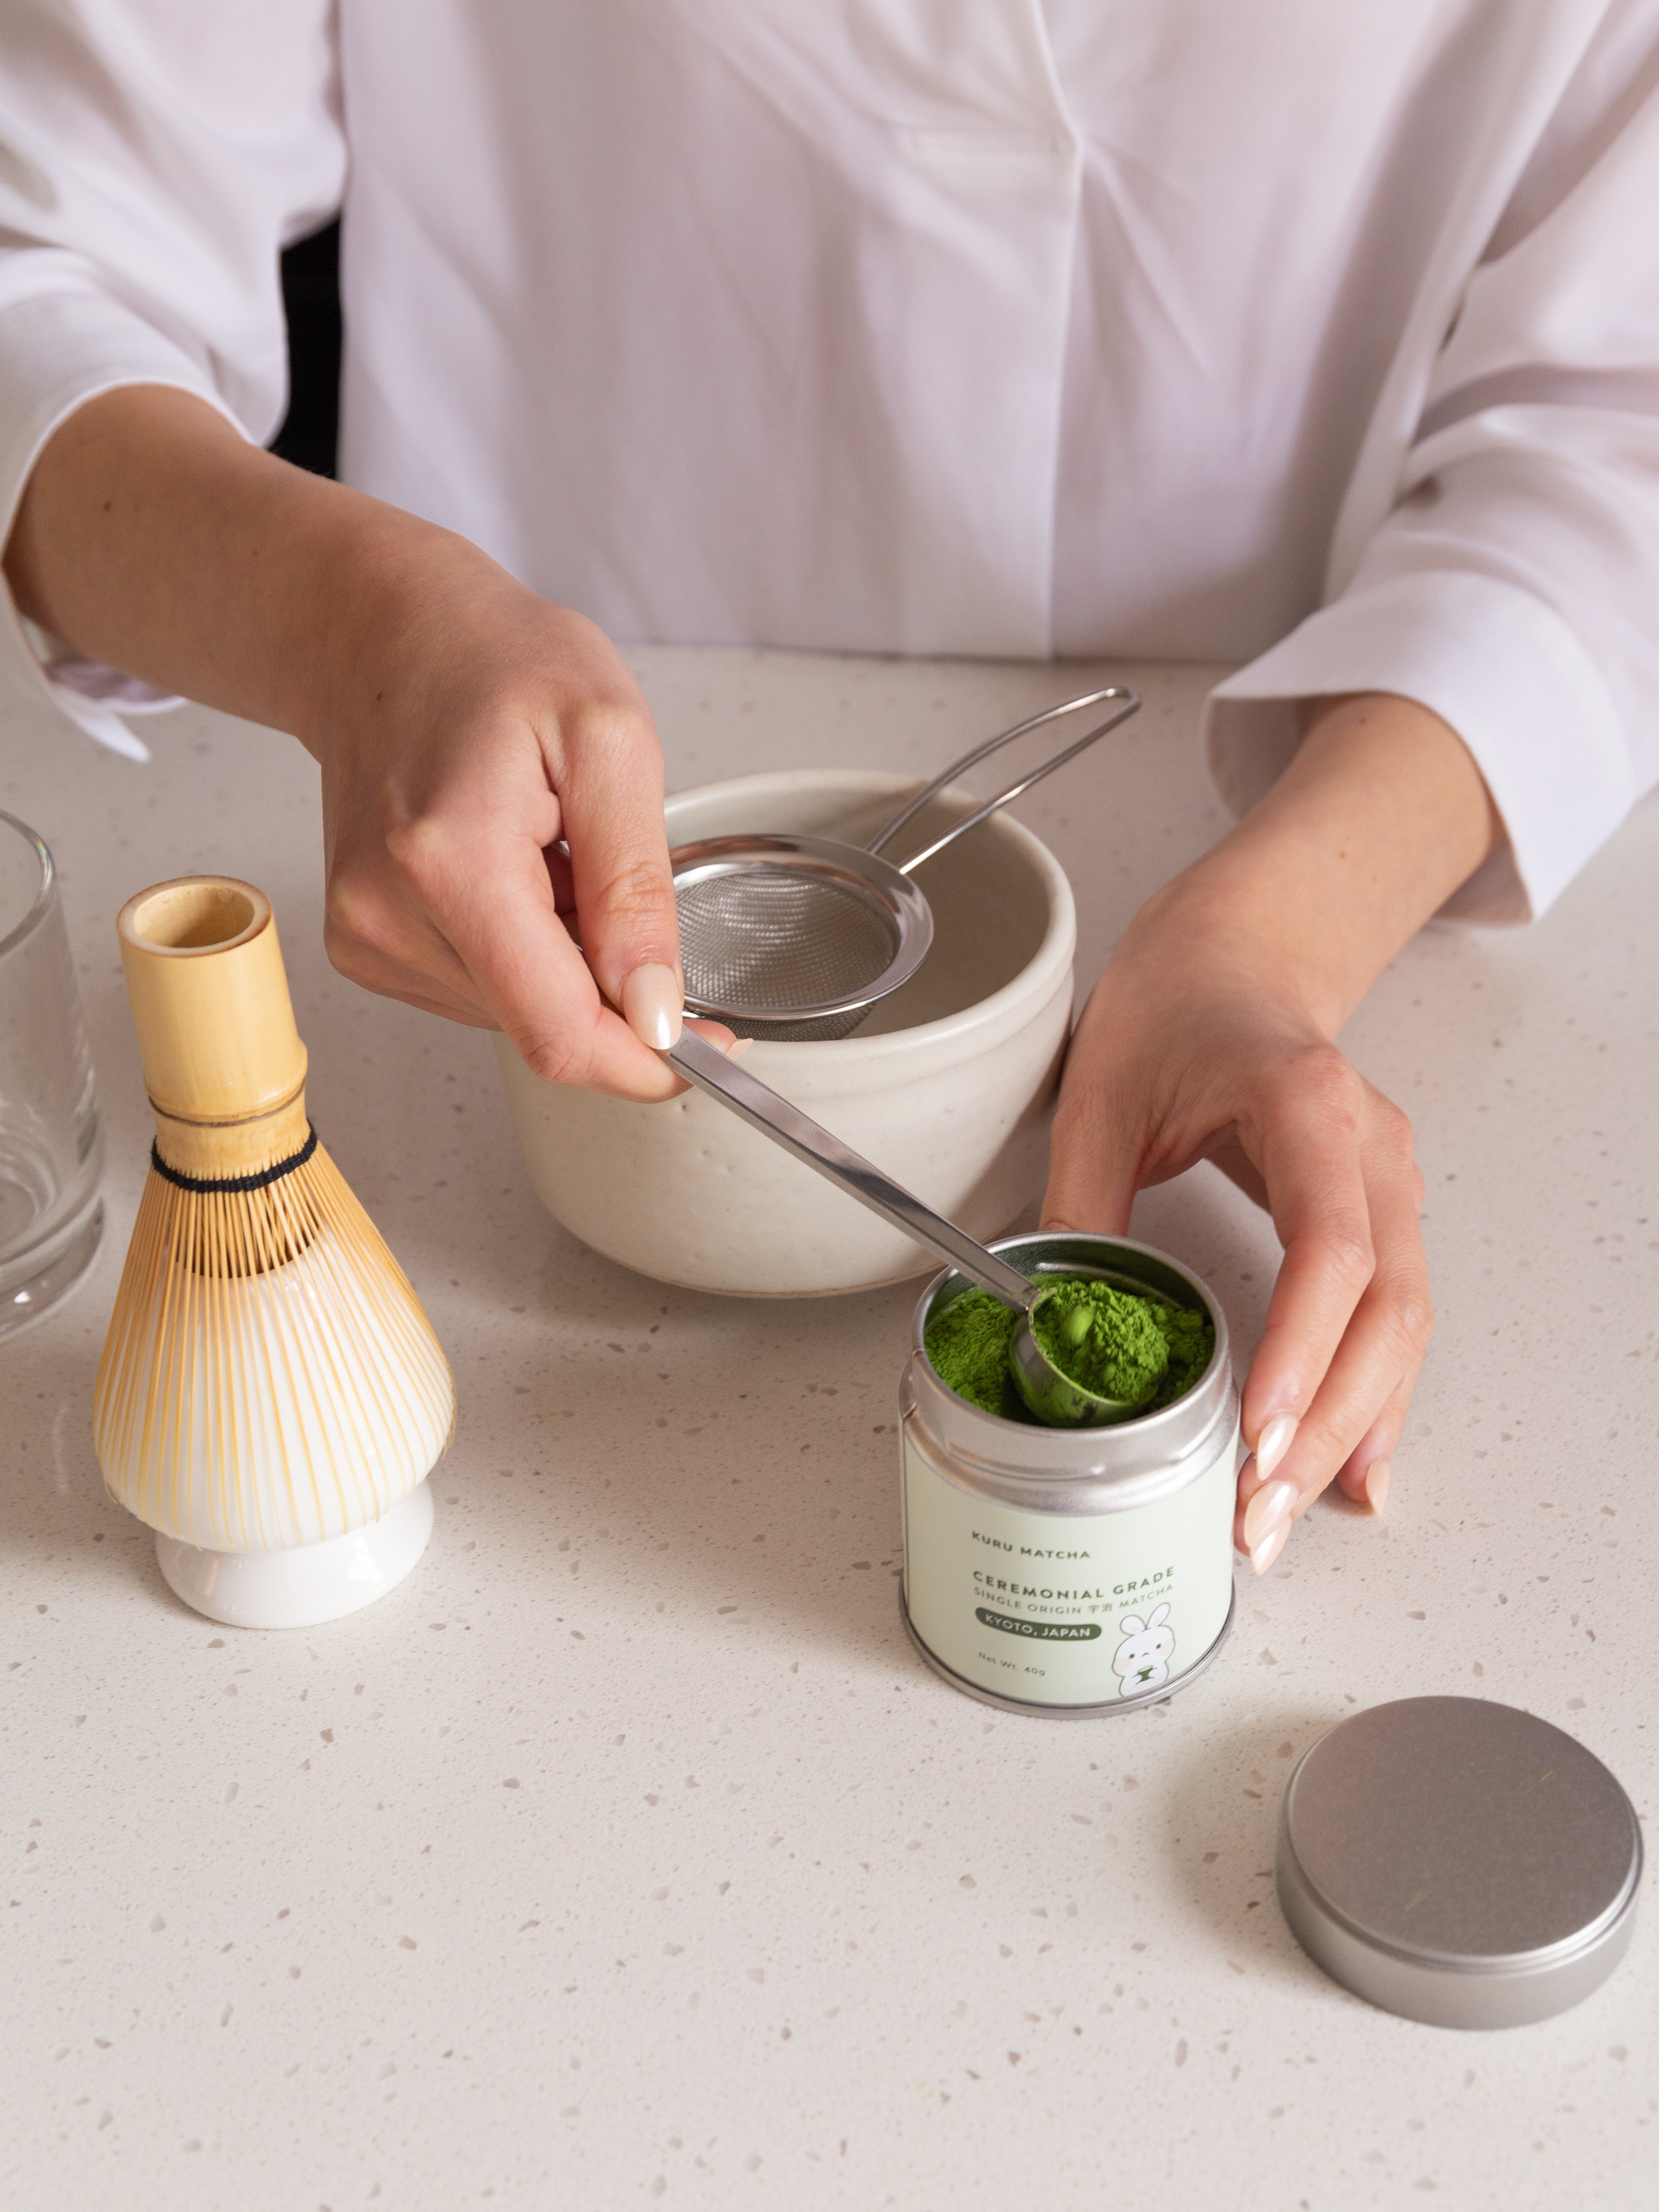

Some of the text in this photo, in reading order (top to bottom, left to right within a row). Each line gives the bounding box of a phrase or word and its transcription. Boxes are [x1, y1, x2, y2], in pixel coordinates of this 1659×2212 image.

[972, 1531, 1091, 1560] KURU MATCHA
[973, 1566, 1175, 1600] CEREMONIAL GRADE
[974, 1584, 1173, 1615] SINGLE ORIGIN 宇治 MATCHA
[985, 1613, 1091, 1638] KYOTO, JAPAN
[978, 1651, 1046, 1678] Net Wt. 40g
